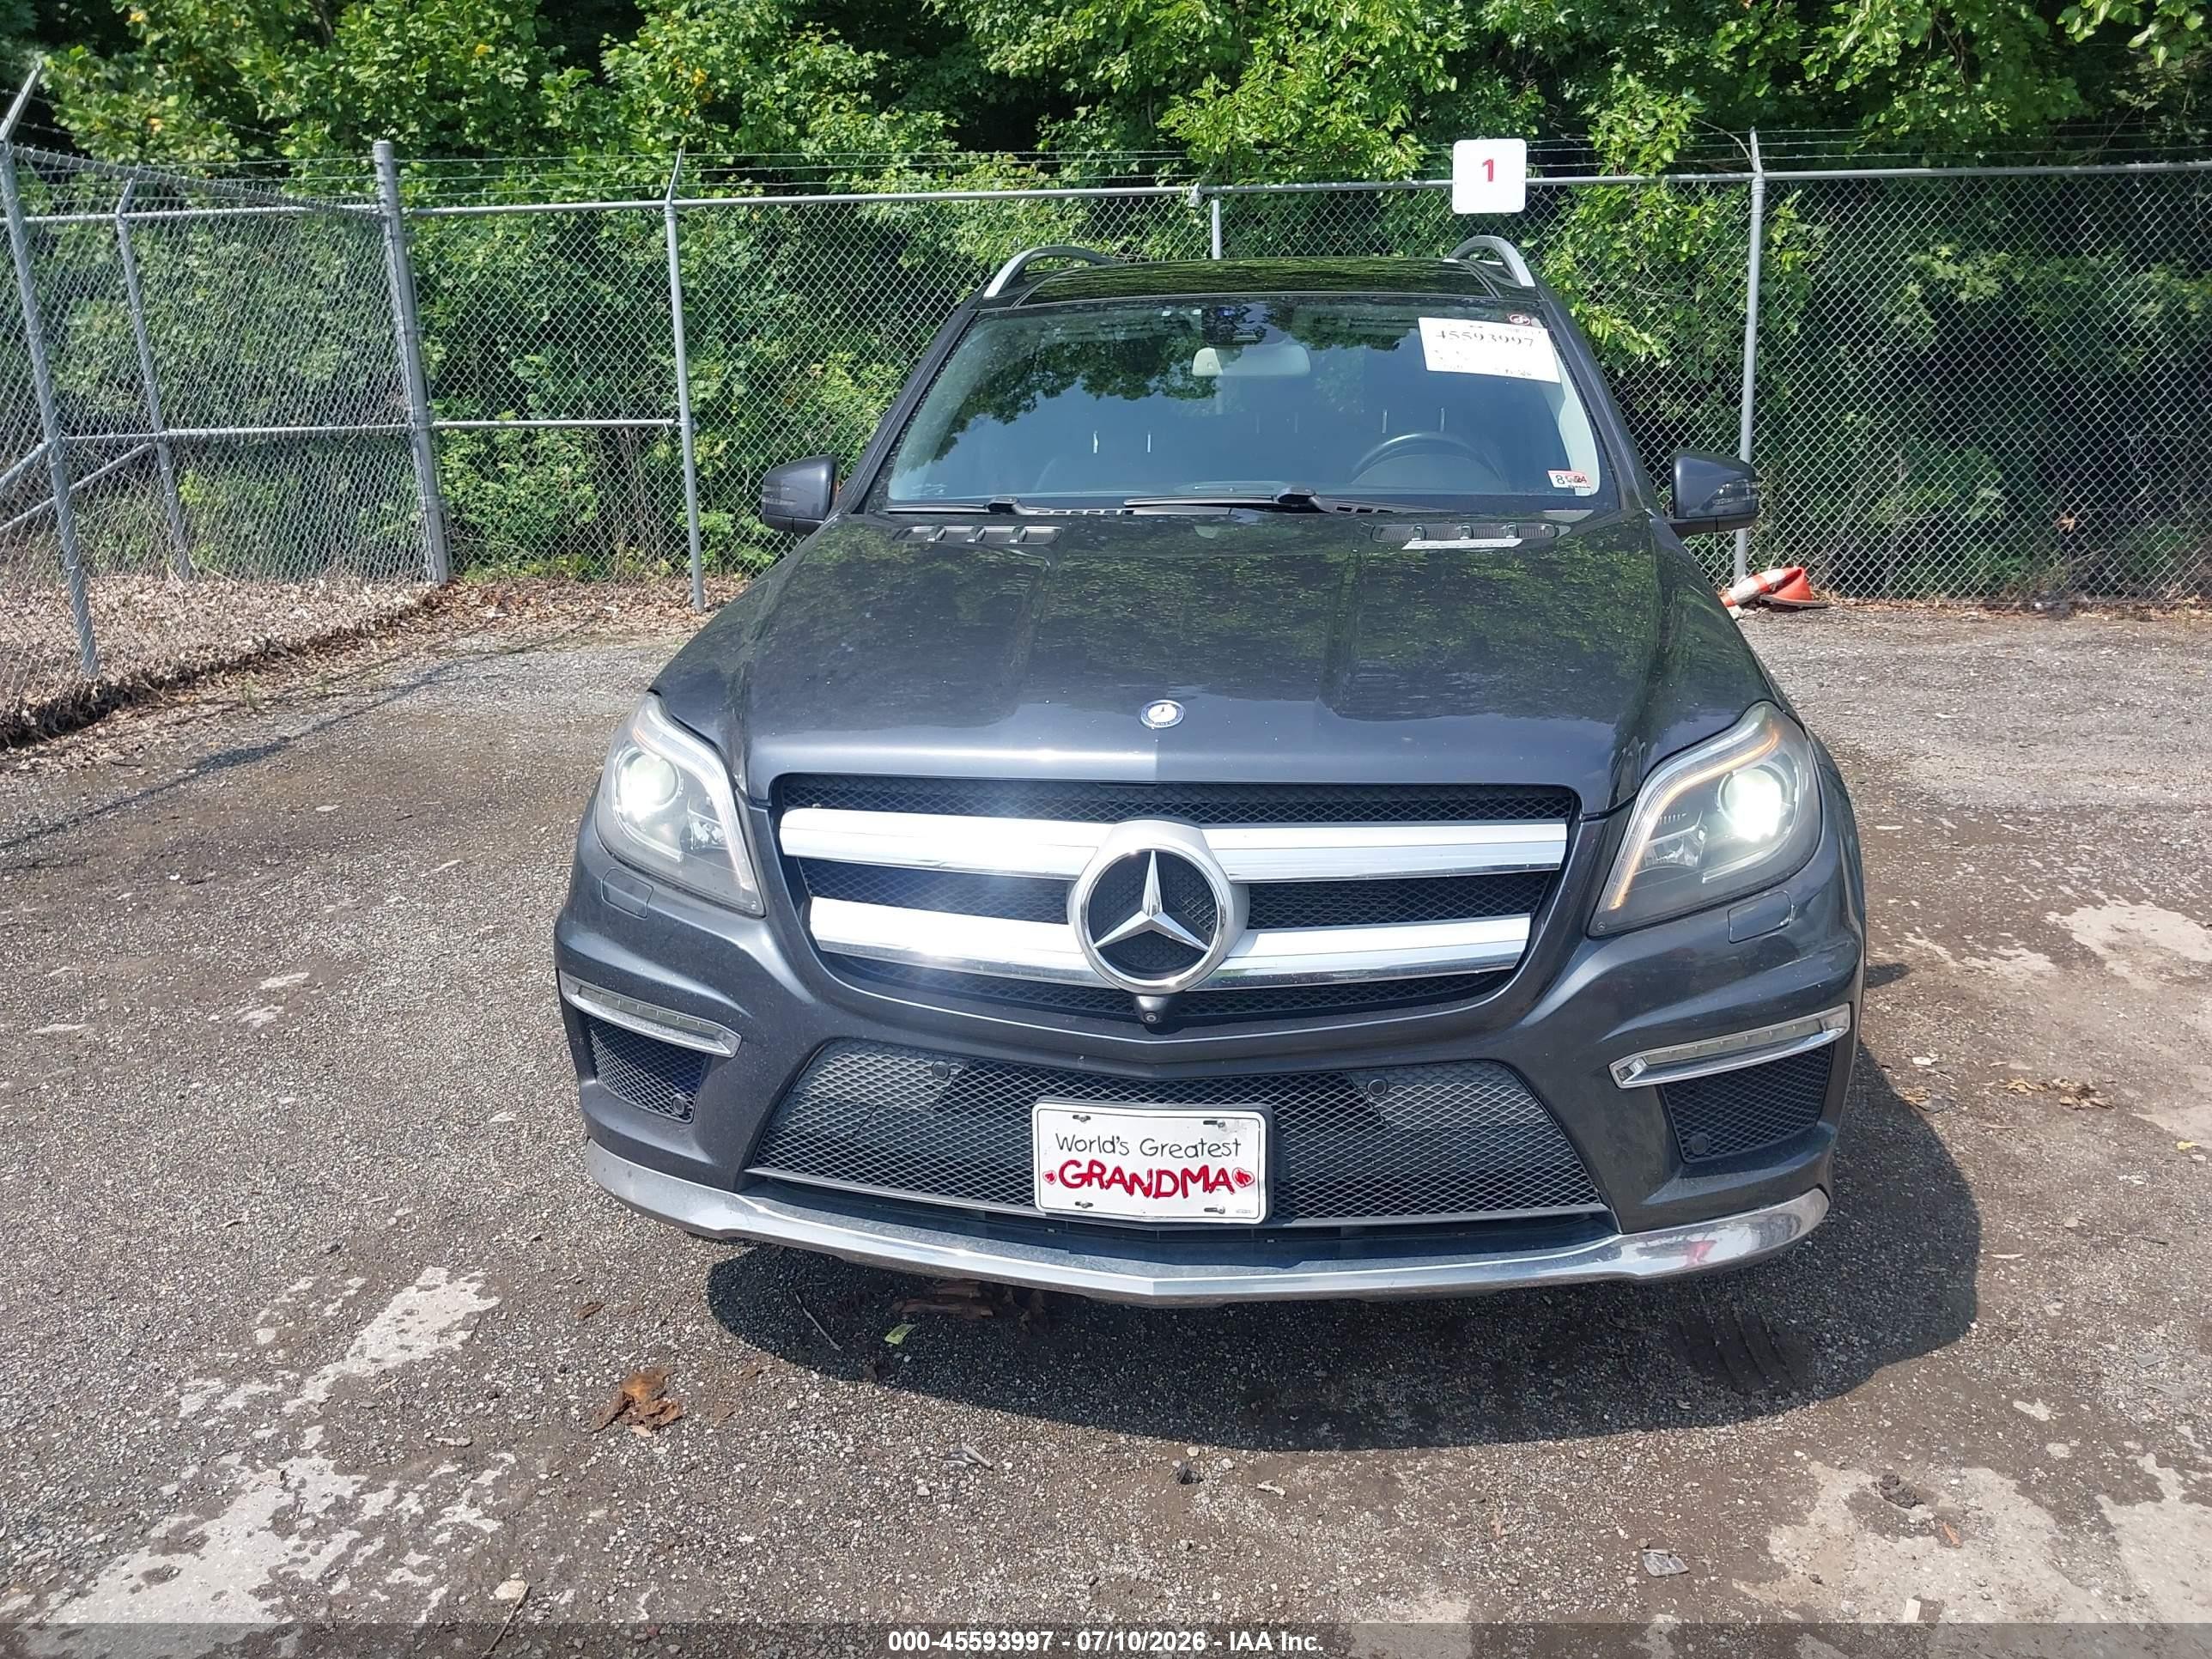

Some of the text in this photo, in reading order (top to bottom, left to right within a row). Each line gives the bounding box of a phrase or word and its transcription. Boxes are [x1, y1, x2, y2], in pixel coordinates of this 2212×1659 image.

[1482, 159, 1494, 182] 1
[1054, 1133, 1242, 1159] World's Greatest
[1058, 1158, 1236, 1199] GRANDMA
